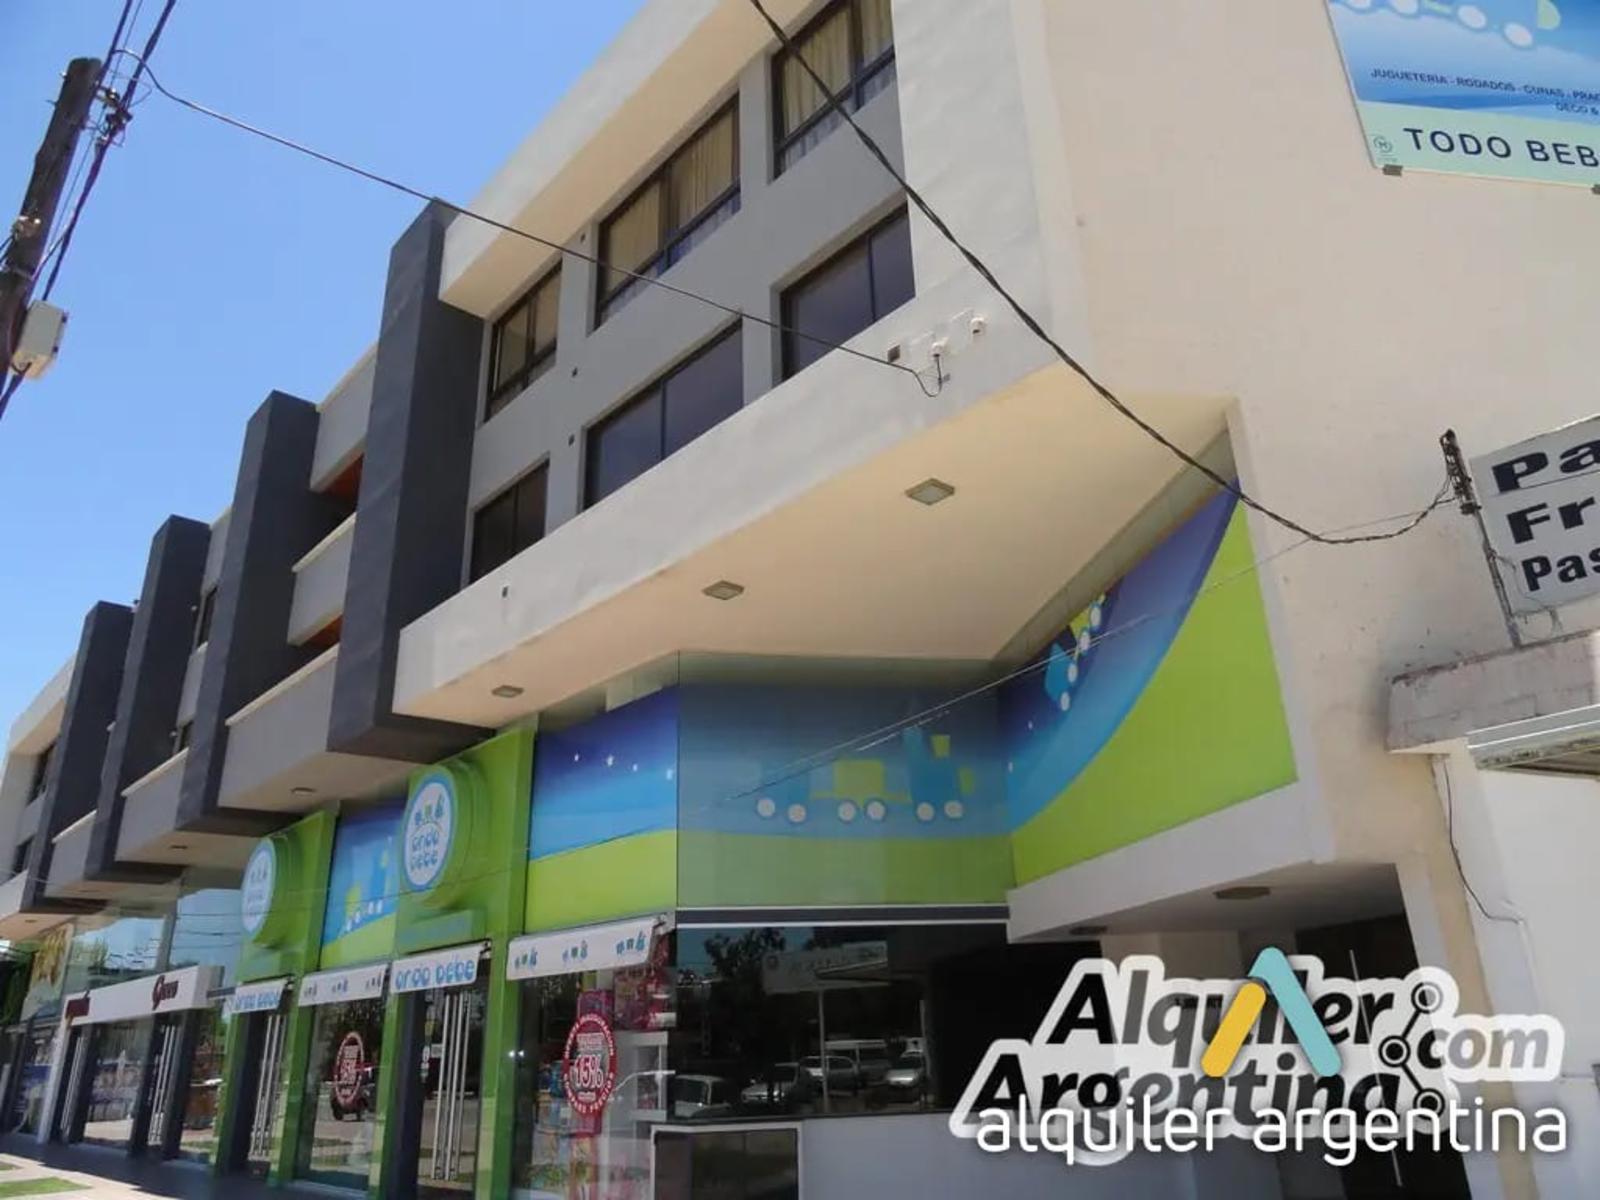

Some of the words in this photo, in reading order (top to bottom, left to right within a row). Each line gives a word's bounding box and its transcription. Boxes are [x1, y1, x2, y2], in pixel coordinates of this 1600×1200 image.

[1371, 68, 1449, 85] JUGUETERIA
[1456, 77, 1516, 92] RODADOS
[1403, 127, 1512, 158] TODO
[1525, 139, 1599, 167] BEB
[1492, 440, 1600, 493] Pa
[1506, 496, 1595, 544] Fr
